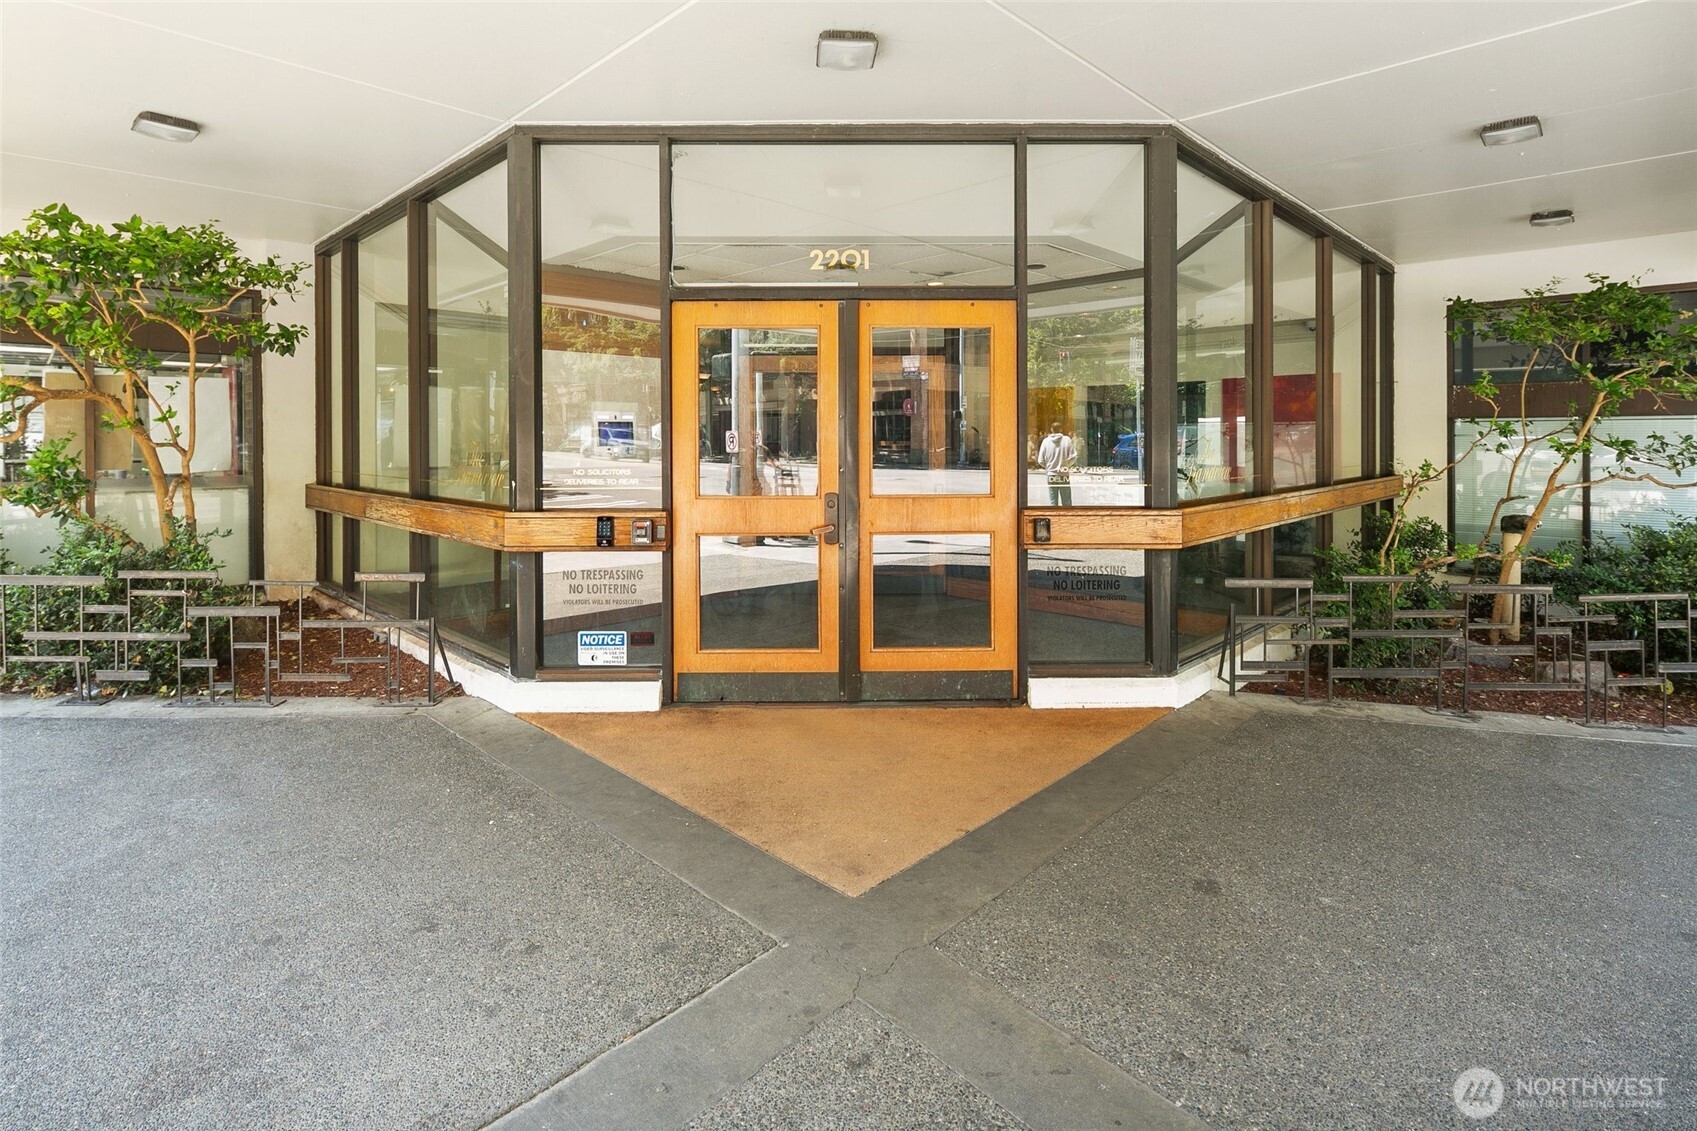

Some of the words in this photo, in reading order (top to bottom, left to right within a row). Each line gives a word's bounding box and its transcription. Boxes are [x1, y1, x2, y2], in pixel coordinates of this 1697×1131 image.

[809, 249, 870, 270] 2201
[572, 468, 585, 476] NO
[587, 468, 632, 476] SOLICITORS
[562, 569, 577, 580] NO
[580, 569, 644, 580] TRESPASSING
[1046, 566, 1061, 576] NO
[1065, 566, 1127, 576] TRESPASSING
[569, 584, 584, 594] NO
[587, 584, 637, 594] LOITERING
[1053, 580, 1068, 590] NO
[1071, 580, 1121, 590] LOITERING
[581, 635, 624, 645] NOTICE
